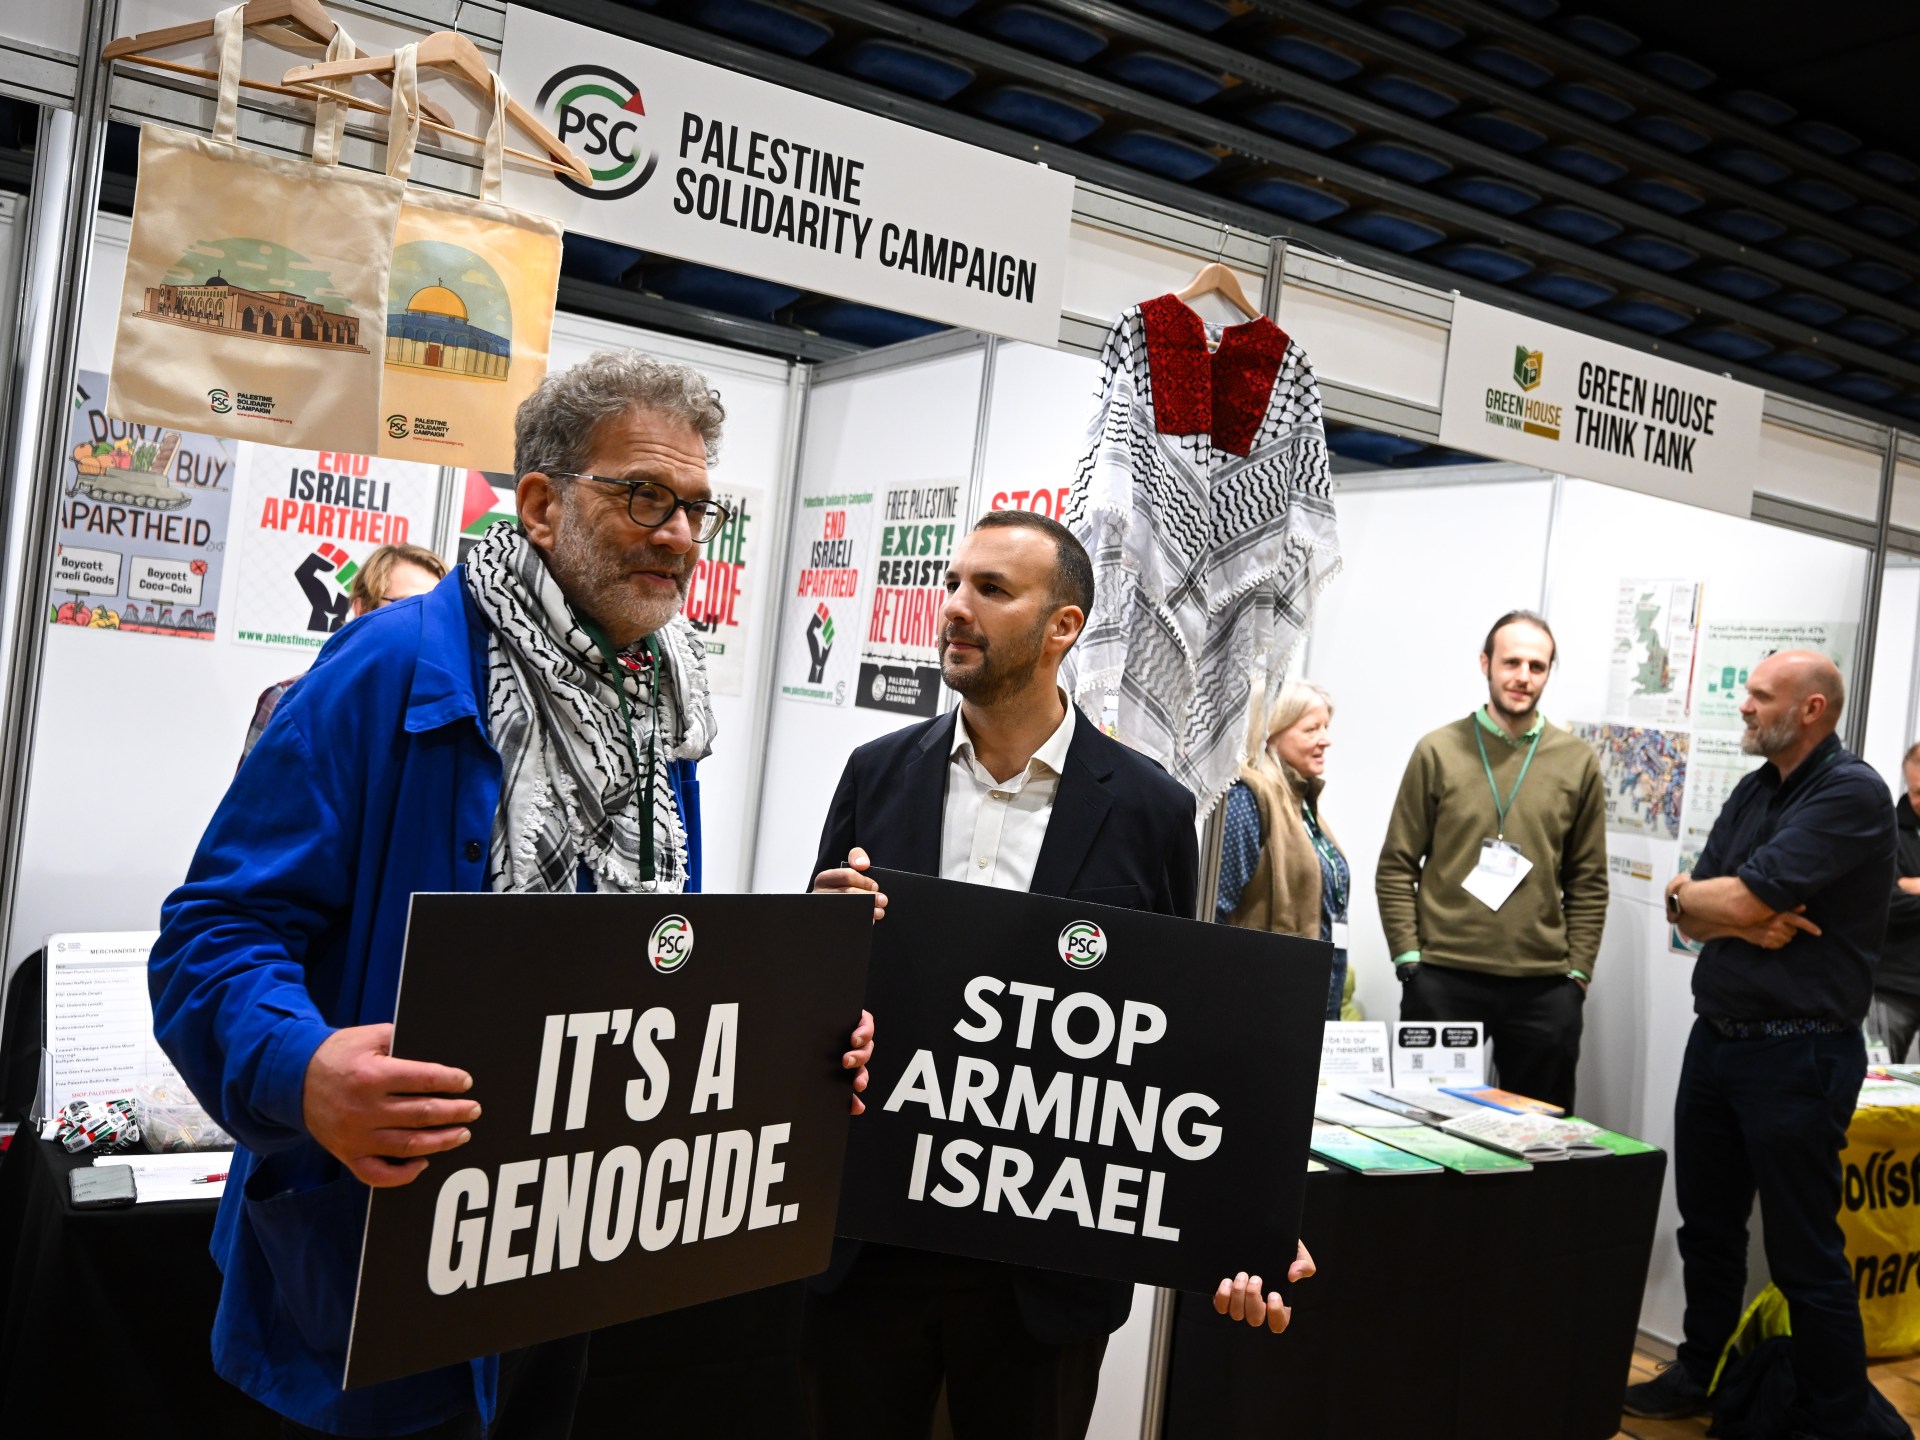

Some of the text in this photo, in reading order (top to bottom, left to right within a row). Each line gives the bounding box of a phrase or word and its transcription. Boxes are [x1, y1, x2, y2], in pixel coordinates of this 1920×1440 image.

[558, 103, 638, 164] PSC
[679, 111, 865, 206] PALESTINE
[673, 167, 1037, 303] SOLIDARITY CAMPAIGN
[212, 396, 229, 407] PSC
[237, 392, 273, 403] PALESTINE
[237, 399, 276, 409] SOLIDARITY
[237, 404, 271, 414] CAMPAIGN
[1485, 388, 1562, 428] GREEN HOUSE
[1578, 361, 1717, 436] GREEN HOUSE
[390, 422, 407, 432] PSC
[413, 428, 445, 438] CAMPAIGN
[414, 417, 447, 427] PALESTINE
[414, 423, 450, 433] SOLIDARITY
[1486, 411, 1522, 431] THINK TANK
[1575, 405, 1696, 474] THINK TANK
[175, 449, 228, 488] BUY
[317, 450, 370, 477] END
[289, 467, 391, 513] ISRAELI
[885, 486, 959, 520] FREE PALESTINE
[260, 496, 409, 545] APARTHEID
[823, 510, 846, 540] END
[810, 539, 853, 569] ISRAELI
[880, 524, 955, 557] EXIST!
[61, 556, 104, 572] Boycott
[147, 567, 188, 582] Boycott
[877, 560, 950, 587] RESIST!
[56, 571, 115, 586] raeli Goods
[139, 579, 193, 595] Coca-Cola
[797, 568, 858, 598] APARTHEID
[680, 559, 746, 627] CIDE
[238, 630, 326, 648] www.palestineca
[887, 685, 921, 697] SOLIDARITY
[888, 676, 920, 688] PALESTINE
[885, 694, 916, 705] CAMPAIGN
[657, 934, 684, 955] PSC
[1067, 935, 1098, 956] PSC
[953, 975, 1167, 1066] STOP
[530, 1002, 739, 1135] IT'S A
[883, 1049, 1223, 1161] ARMING
[908, 1133, 1180, 1242] ISRAEL
[427, 1122, 800, 1295] GENOCIDE.
